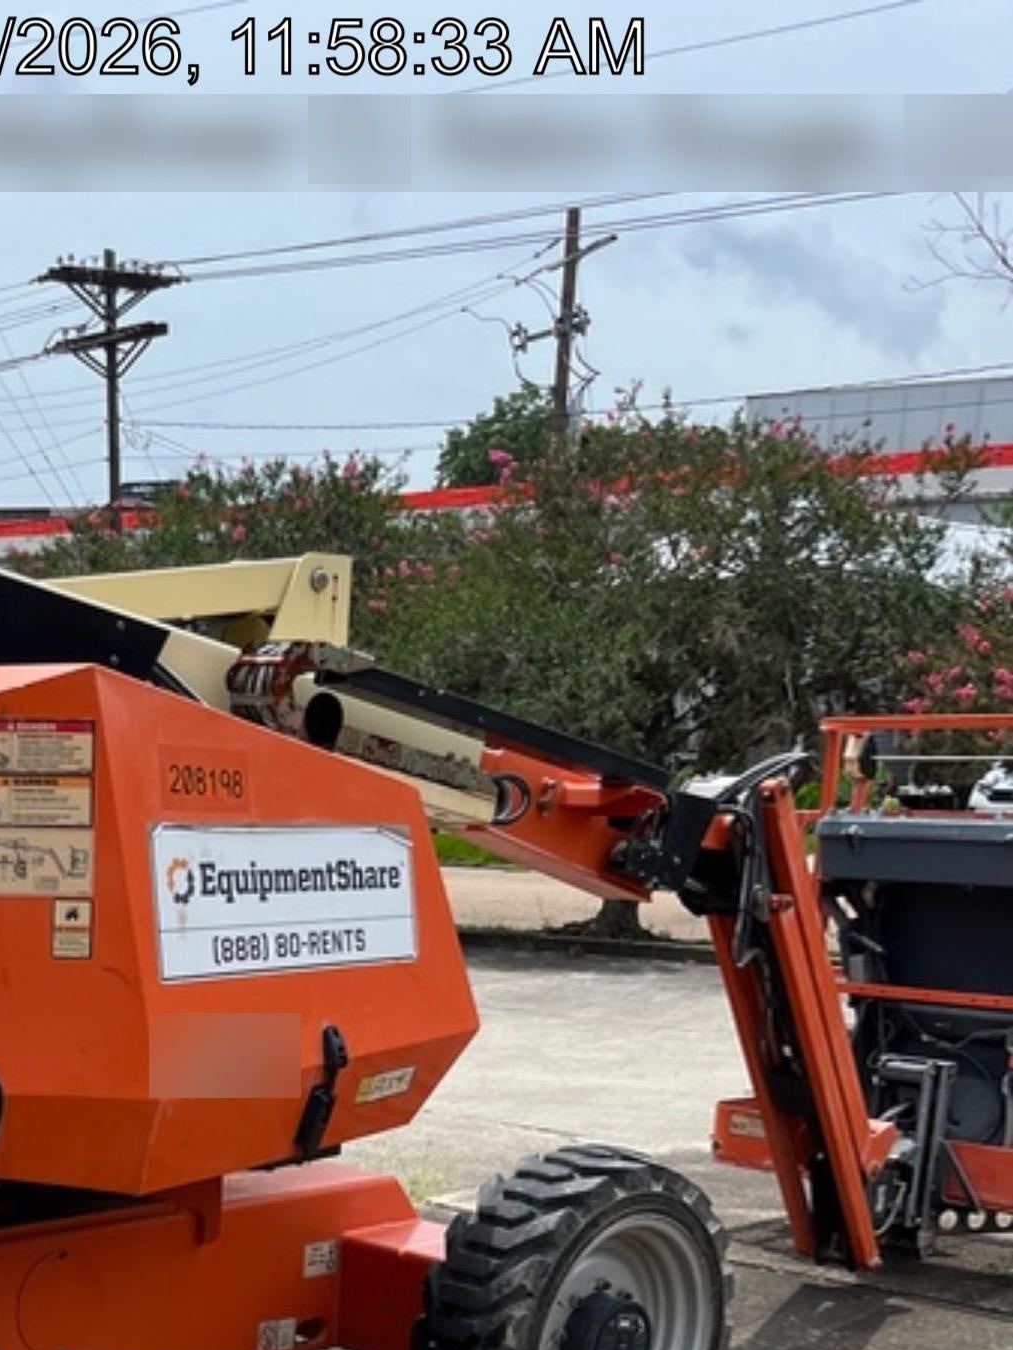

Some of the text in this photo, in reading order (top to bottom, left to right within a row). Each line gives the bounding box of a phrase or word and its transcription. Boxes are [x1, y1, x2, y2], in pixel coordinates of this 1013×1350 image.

[169, 764, 242, 799] 208198
[199, 860, 402, 904] EquipmentShare
[212, 928, 366, 966] (888) 80-RENTS
